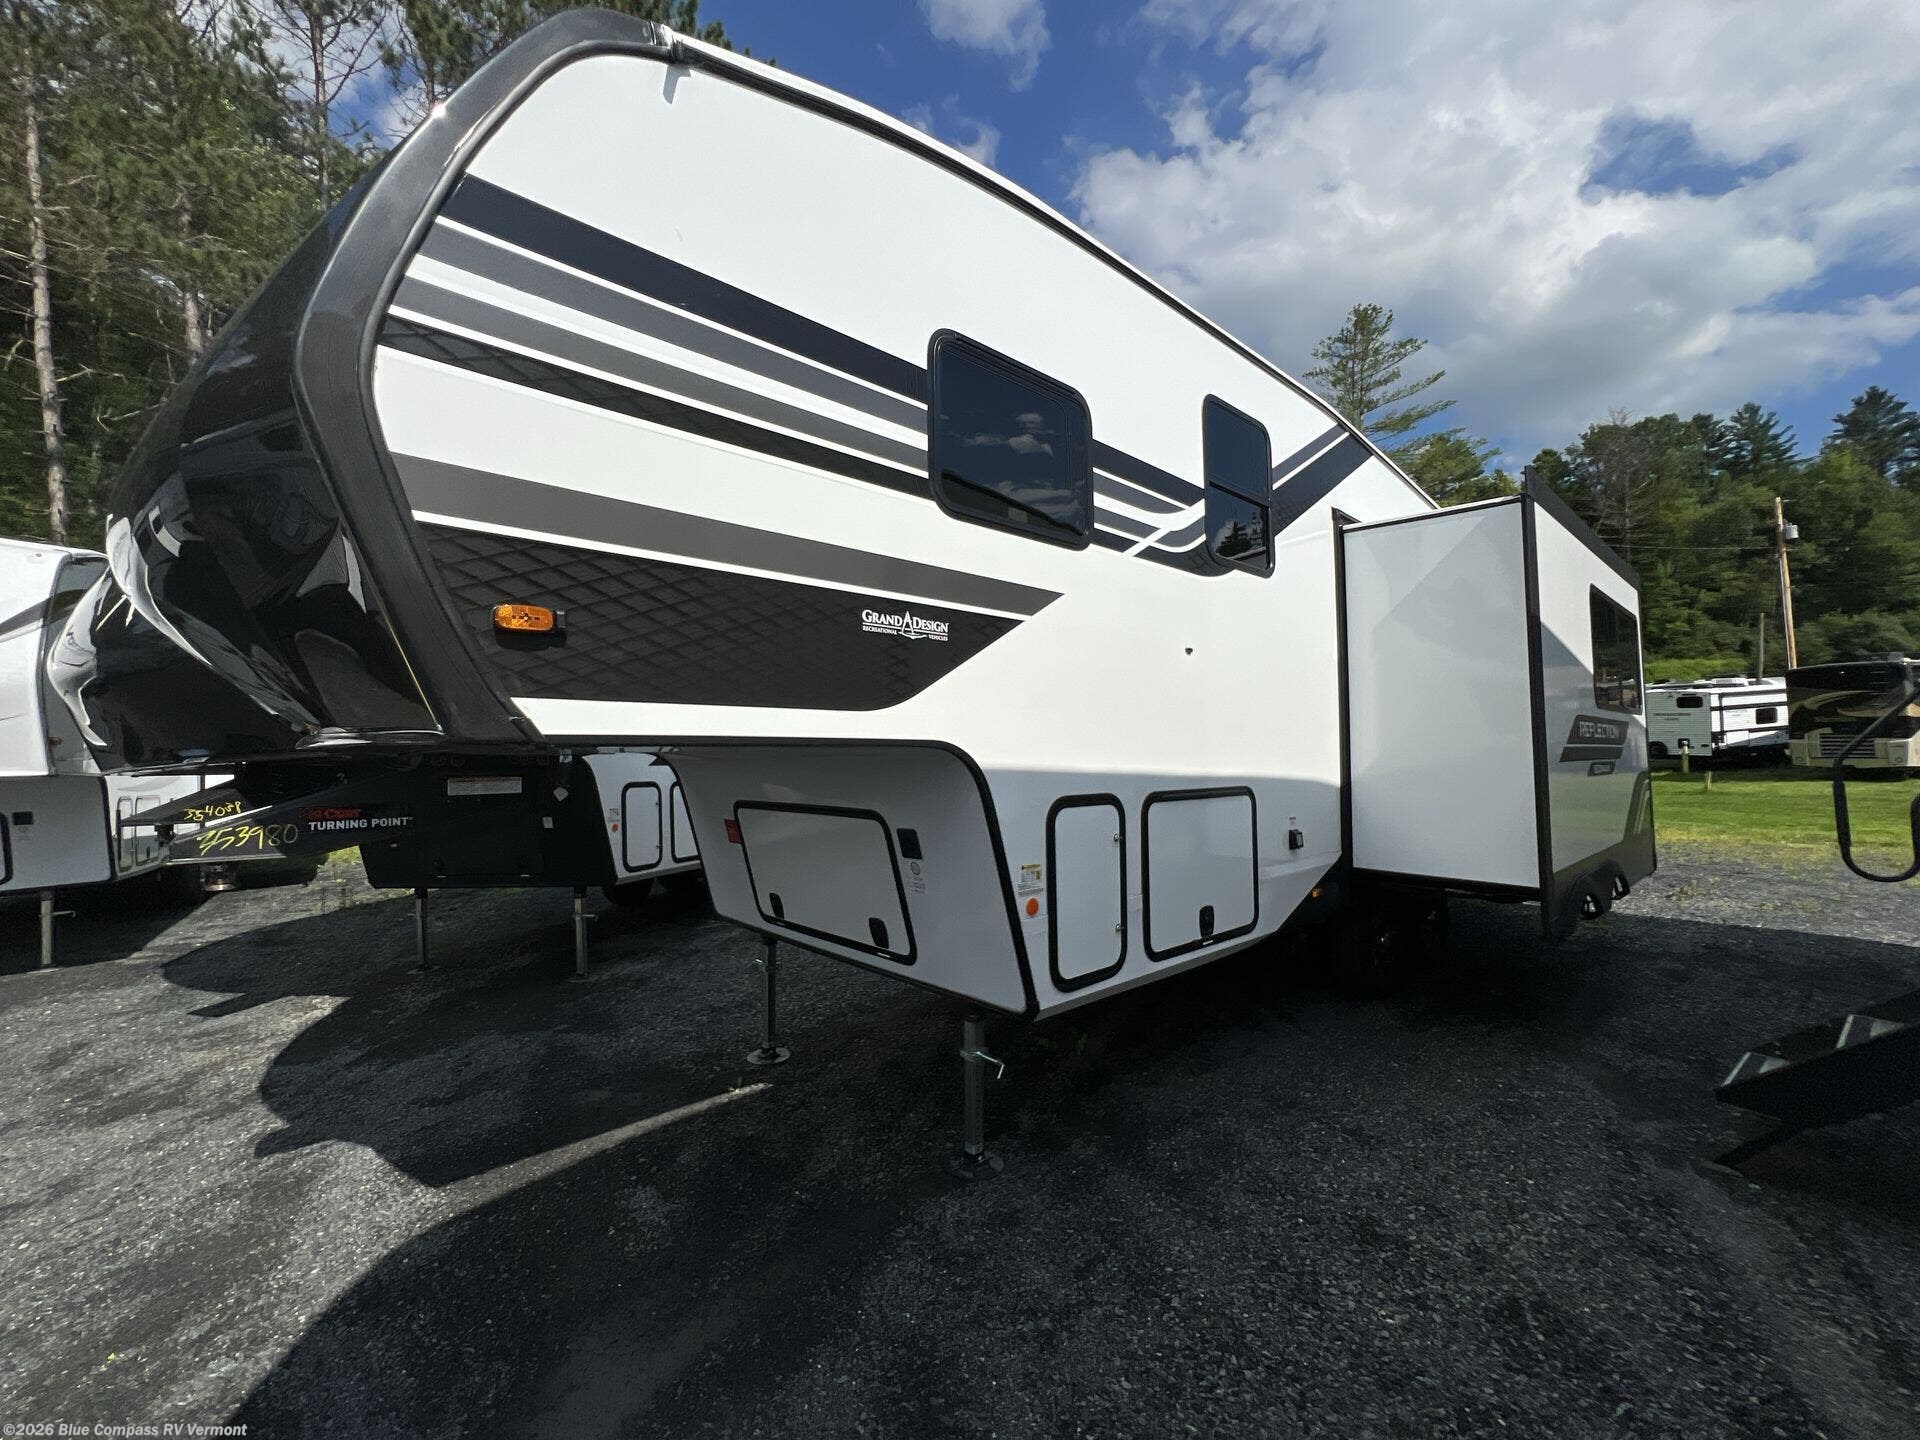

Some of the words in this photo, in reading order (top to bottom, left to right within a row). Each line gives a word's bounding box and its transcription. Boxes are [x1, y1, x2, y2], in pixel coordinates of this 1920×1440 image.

[861, 609, 903, 627] GRAND
[912, 615, 950, 633] DESIGN
[862, 625, 898, 635] RECREATIONAL
[308, 819, 368, 831] TURNING
[371, 816, 410, 828] POINT
